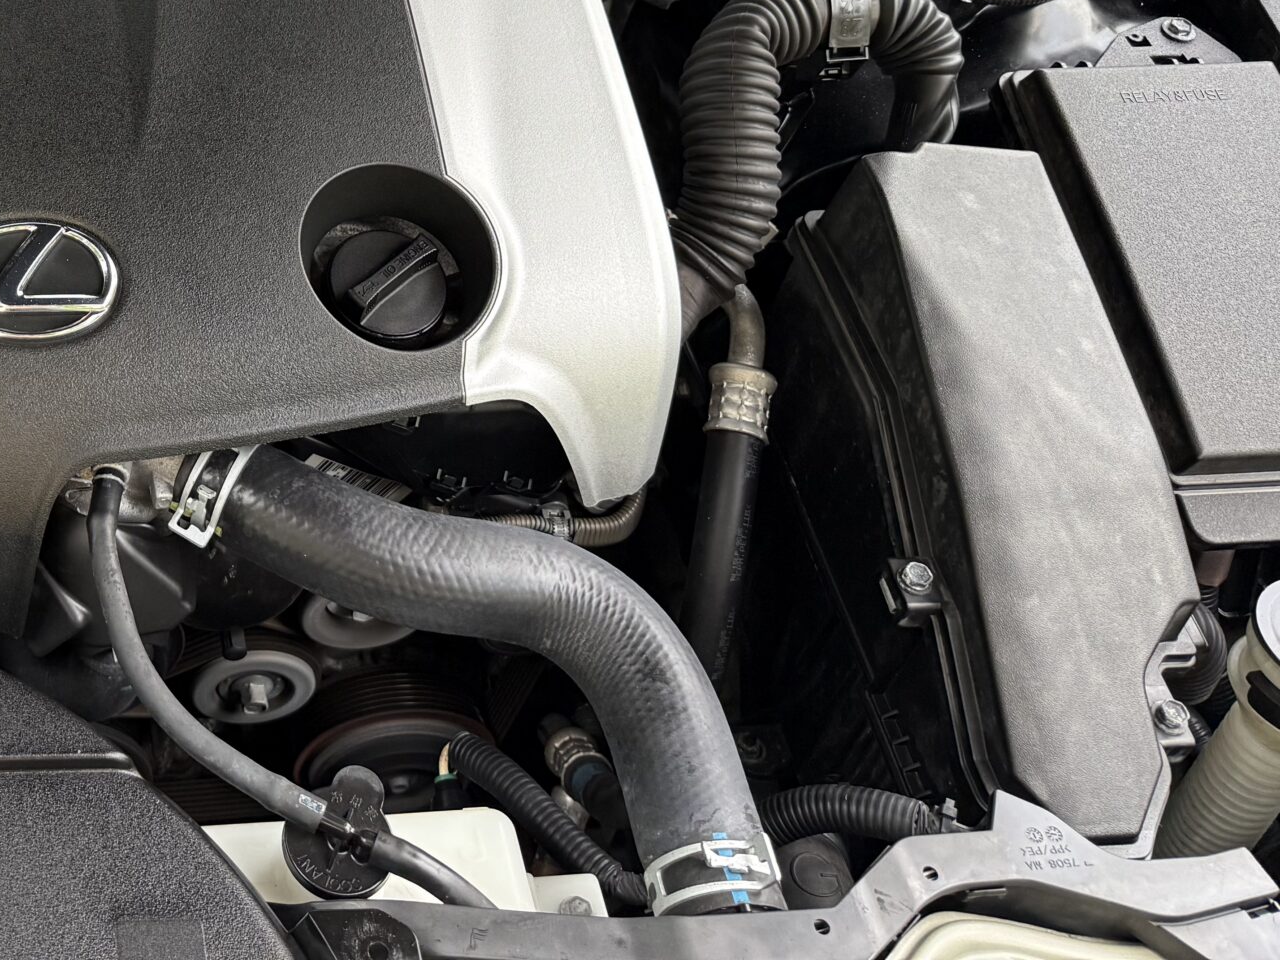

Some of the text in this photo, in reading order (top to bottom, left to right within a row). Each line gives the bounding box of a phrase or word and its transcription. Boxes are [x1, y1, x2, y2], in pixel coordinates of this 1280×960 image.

[1119, 88, 1229, 103] RELAY&FUSE
[379, 240, 430, 279] ENGINE OIL
[296, 854, 364, 893] COOLANT
